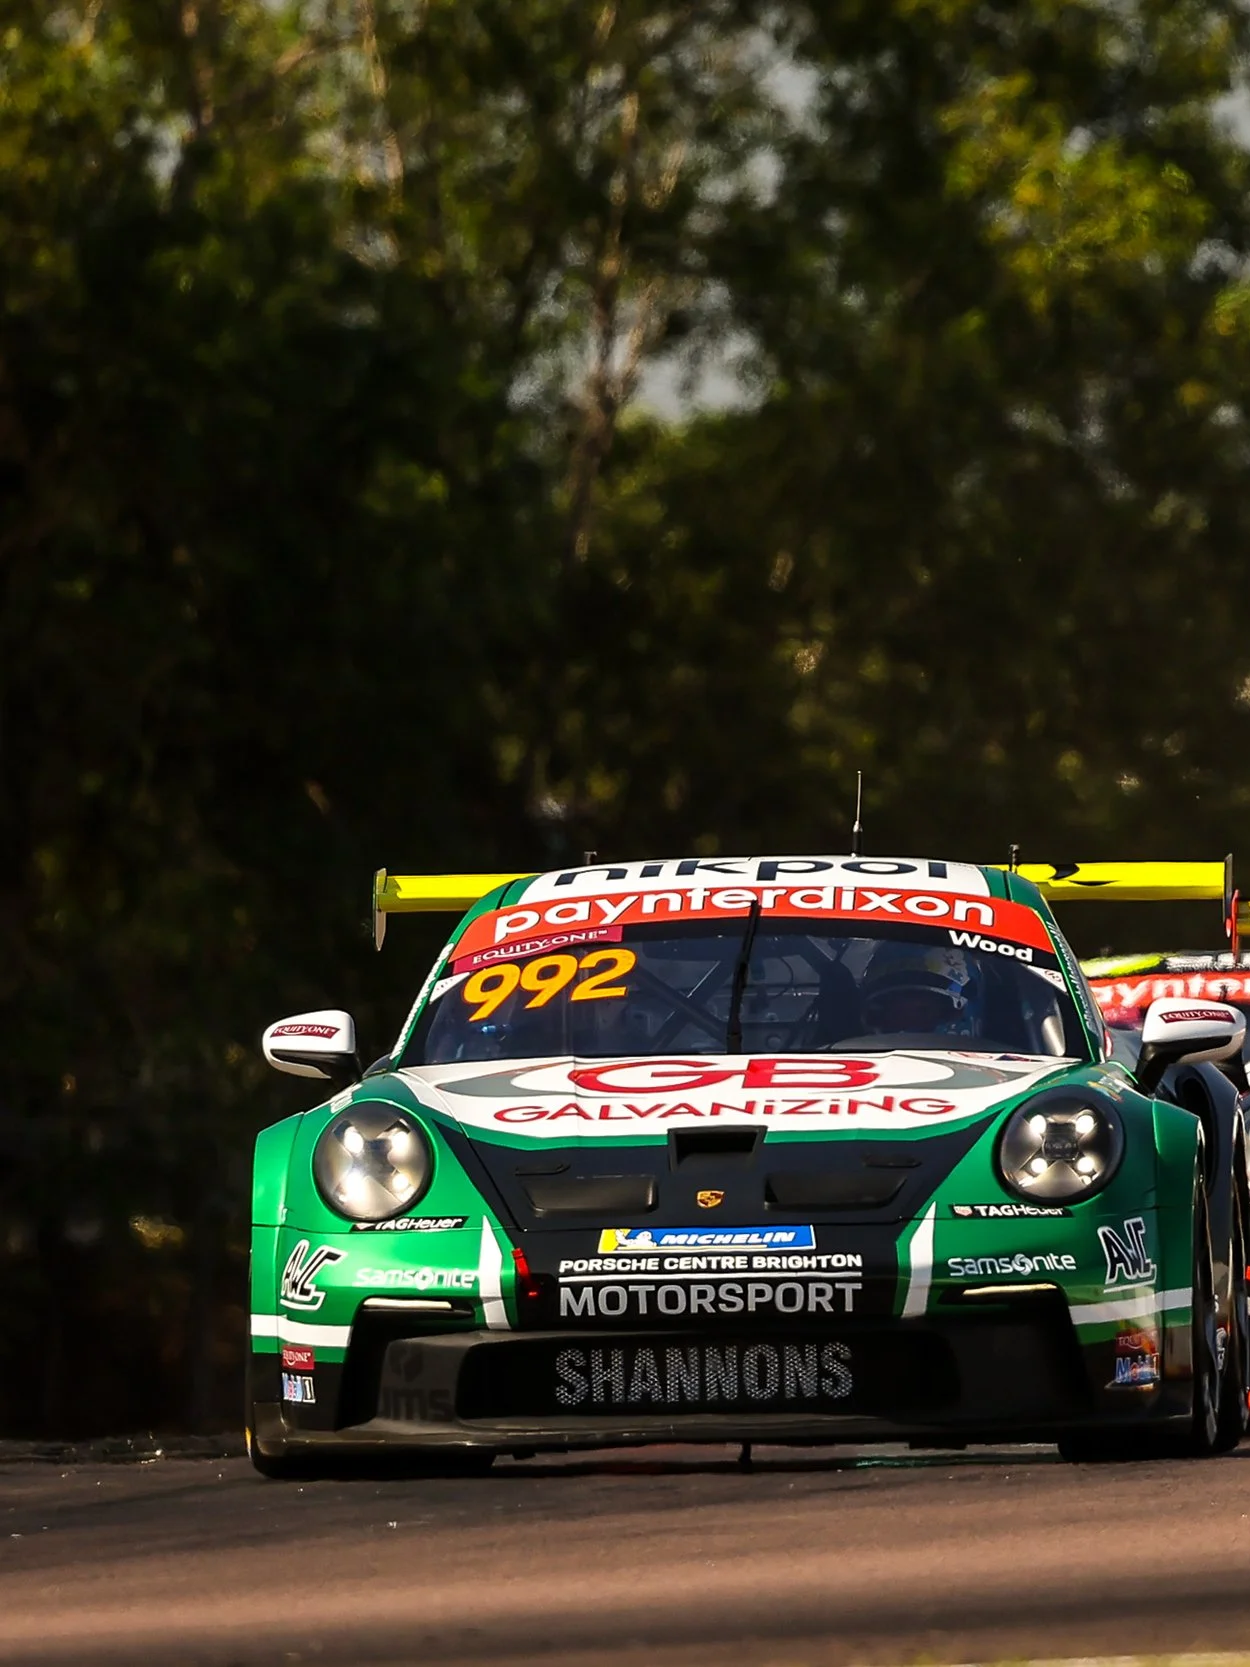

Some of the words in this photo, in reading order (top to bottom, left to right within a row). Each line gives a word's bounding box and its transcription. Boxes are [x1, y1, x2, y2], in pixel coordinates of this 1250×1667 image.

[493, 886, 995, 944] paynterdixon
[949, 930, 1033, 962] Wood
[464, 948, 636, 1022] 992
[567, 1058, 881, 1093] GB
[660, 1231, 796, 1245] MICHELIN
[559, 1257, 660, 1273] PORSCHE
[663, 1255, 748, 1270] CENTRE
[752, 1253, 863, 1270] BRIGHTON
[947, 1252, 1077, 1276] Samsonite
[559, 1281, 863, 1318] MOTORSPORT
[555, 1341, 853, 1406] SHANNONS
